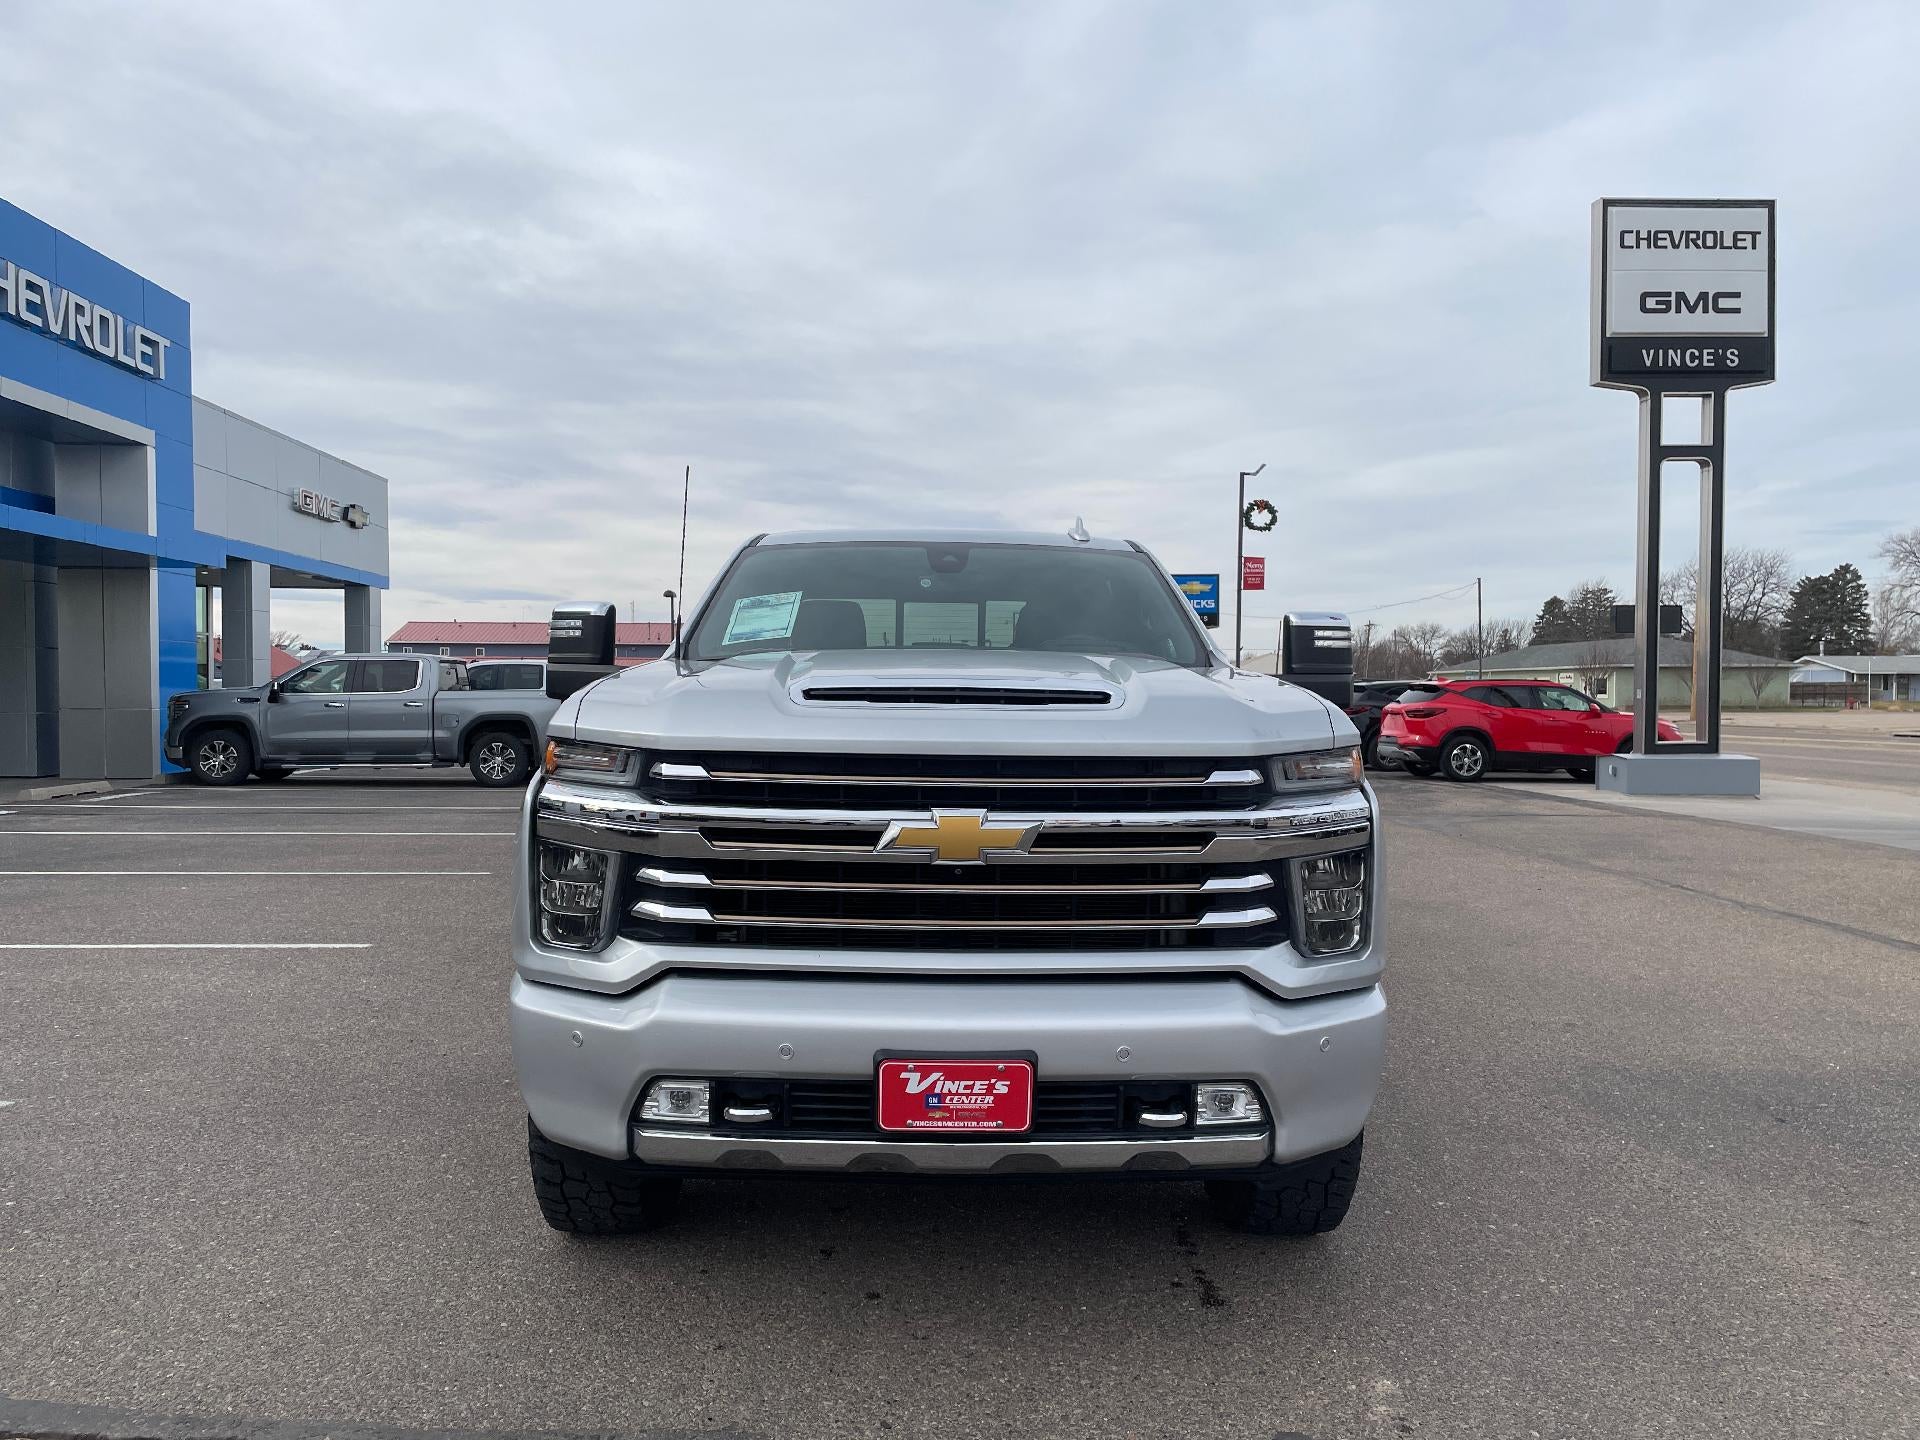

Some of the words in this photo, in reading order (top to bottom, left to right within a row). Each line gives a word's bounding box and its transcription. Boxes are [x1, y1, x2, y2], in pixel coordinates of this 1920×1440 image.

[1619, 229, 1762, 250] CHEVROLET
[1639, 291, 1742, 314] GMC
[0, 260, 171, 380] HEVROLET
[1641, 348, 1740, 367] VINCE'S
[299, 487, 341, 523] GMC
[945, 1095, 995, 1104] CENTER
